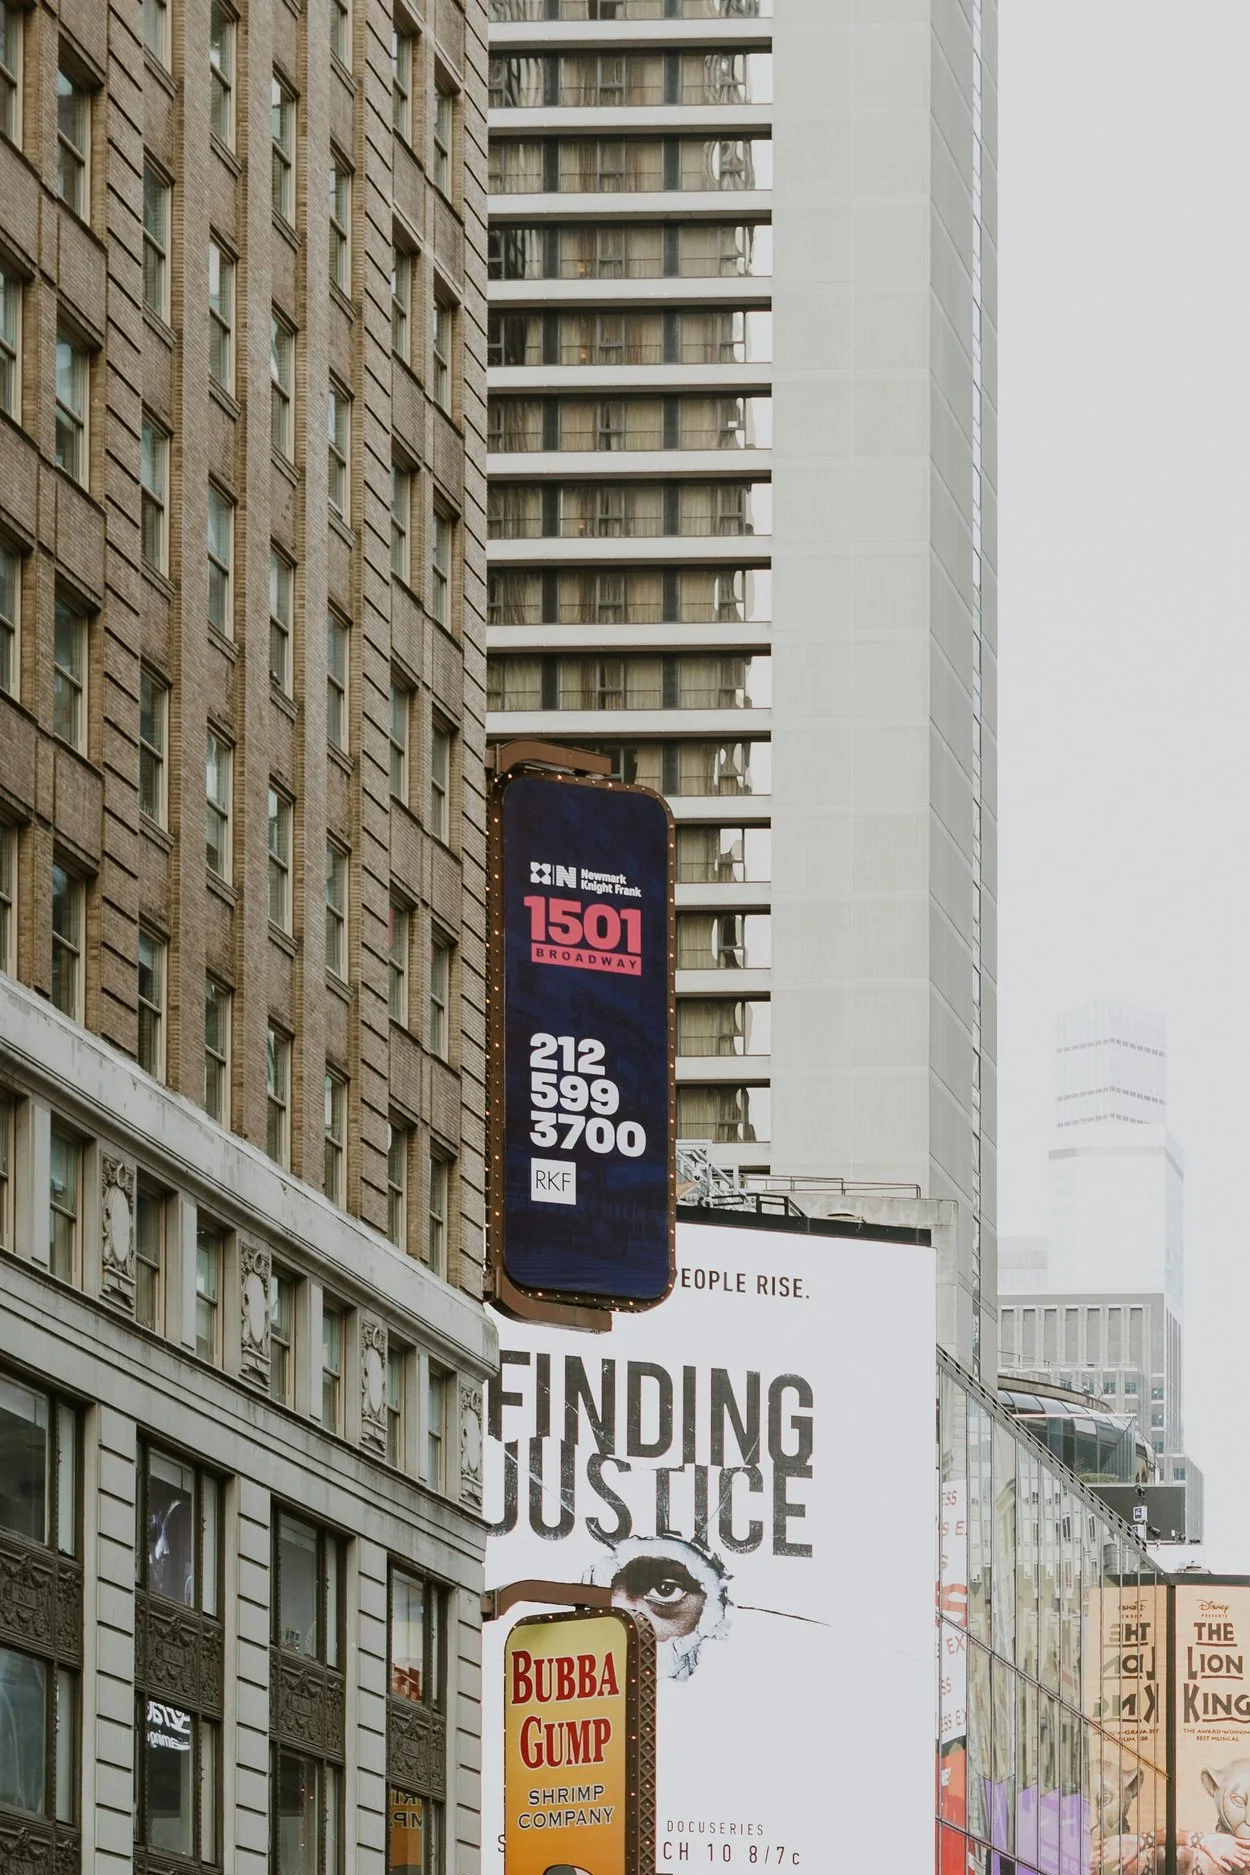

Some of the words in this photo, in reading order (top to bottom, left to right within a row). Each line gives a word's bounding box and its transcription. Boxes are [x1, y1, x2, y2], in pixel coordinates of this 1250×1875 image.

[580, 868, 627, 886] Newmark
[580, 879, 613, 897] Knight
[614, 881, 643, 898] Frank
[523, 895, 642, 955] 1501
[535, 947, 639, 971] BROADWAY
[529, 1032, 606, 1076] 212
[530, 1073, 620, 1116] 599
[529, 1110, 647, 1158] 3700
[535, 1171, 571, 1193] RKF
[676, 1267, 747, 1294] EOPLE
[757, 1273, 810, 1300] RISE.
[488, 1349, 814, 1468] FINDING
[487, 1435, 814, 1559] JUSTICE
[1193, 1622, 1235, 1642] THE
[511, 1648, 620, 1705] BUBBA
[1187, 1646, 1244, 1680] LION
[519, 1716, 613, 1770] GUMP
[528, 1783, 606, 1807] SHRIMP
[517, 1805, 615, 1831] COMPANY
[666, 1820, 765, 1837] DOCUSERIES
[707, 1843, 732, 1864] 10
[749, 1844, 801, 1866] 8/7c
